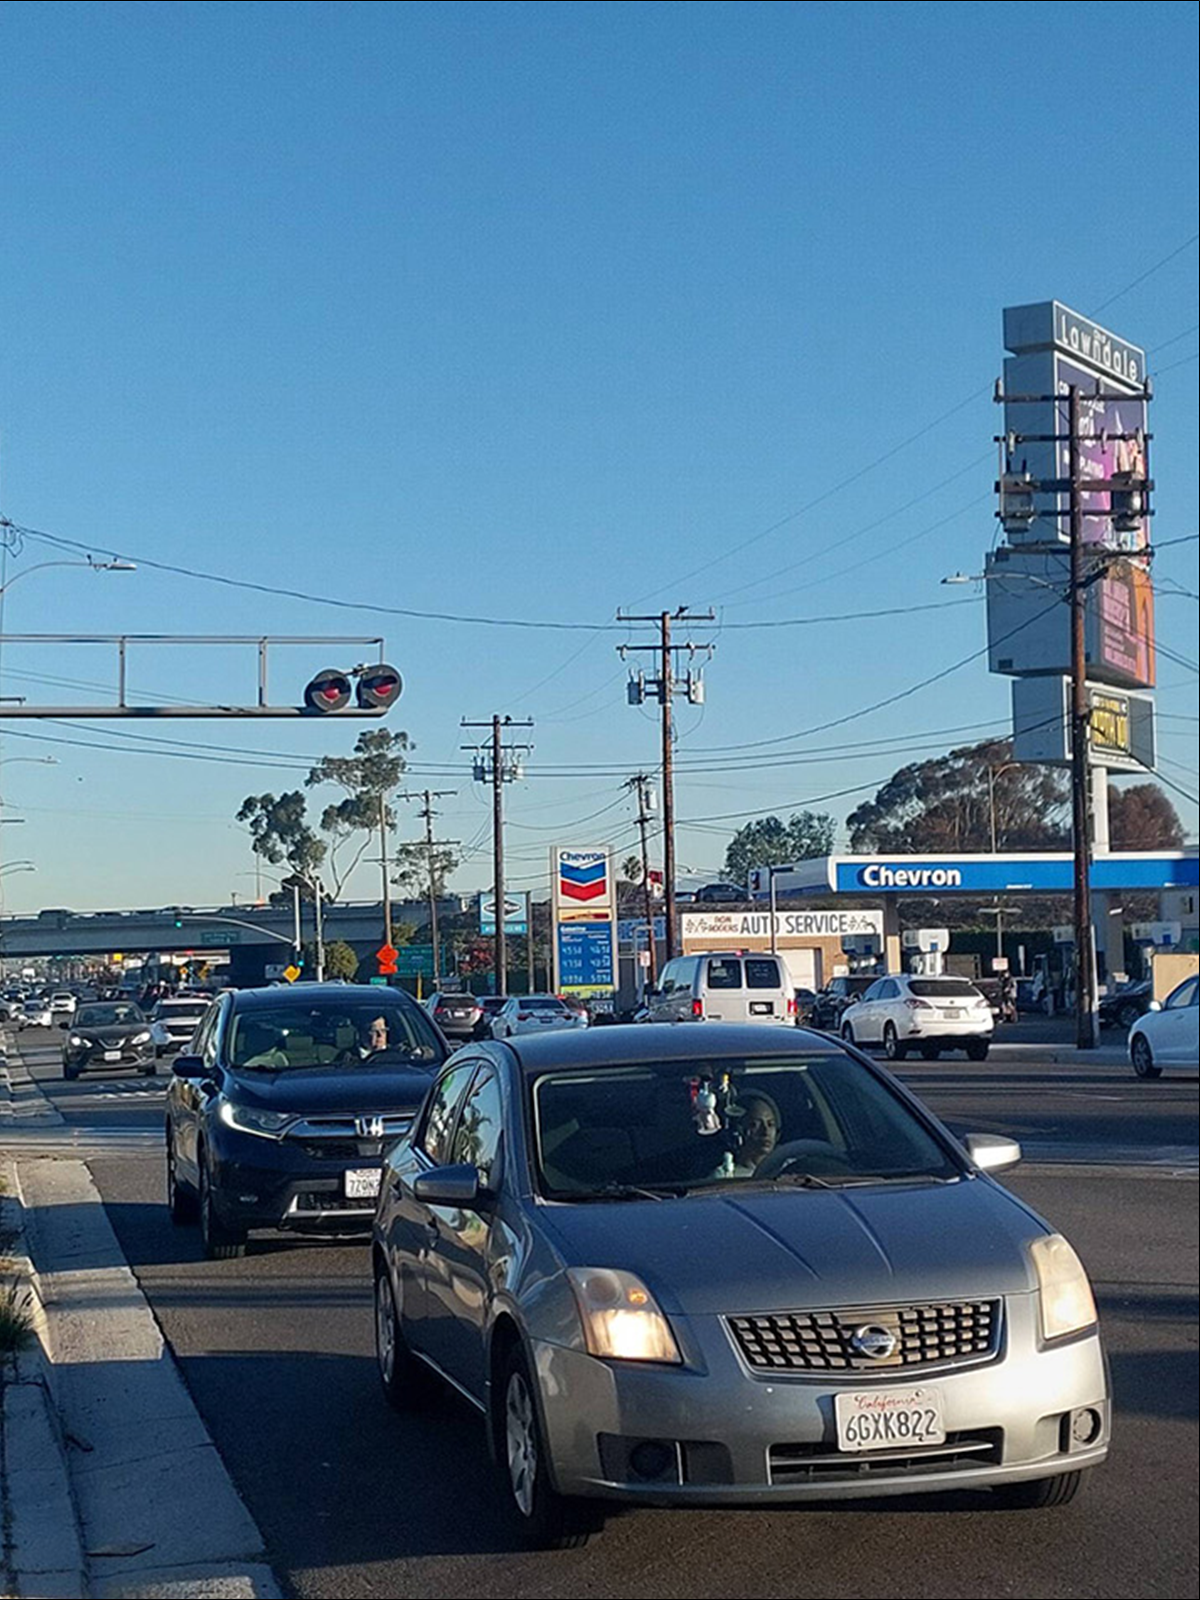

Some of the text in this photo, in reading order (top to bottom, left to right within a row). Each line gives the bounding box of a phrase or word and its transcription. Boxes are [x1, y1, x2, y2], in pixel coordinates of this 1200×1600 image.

[1061, 314, 1137, 382] Lawndale
[559, 851, 606, 862] Chevron
[863, 864, 962, 887] Chevron
[740, 914, 848, 935] AUTO SERVICE
[858, 1396, 917, 1411] California
[846, 1409, 937, 1442] 6GXK822
